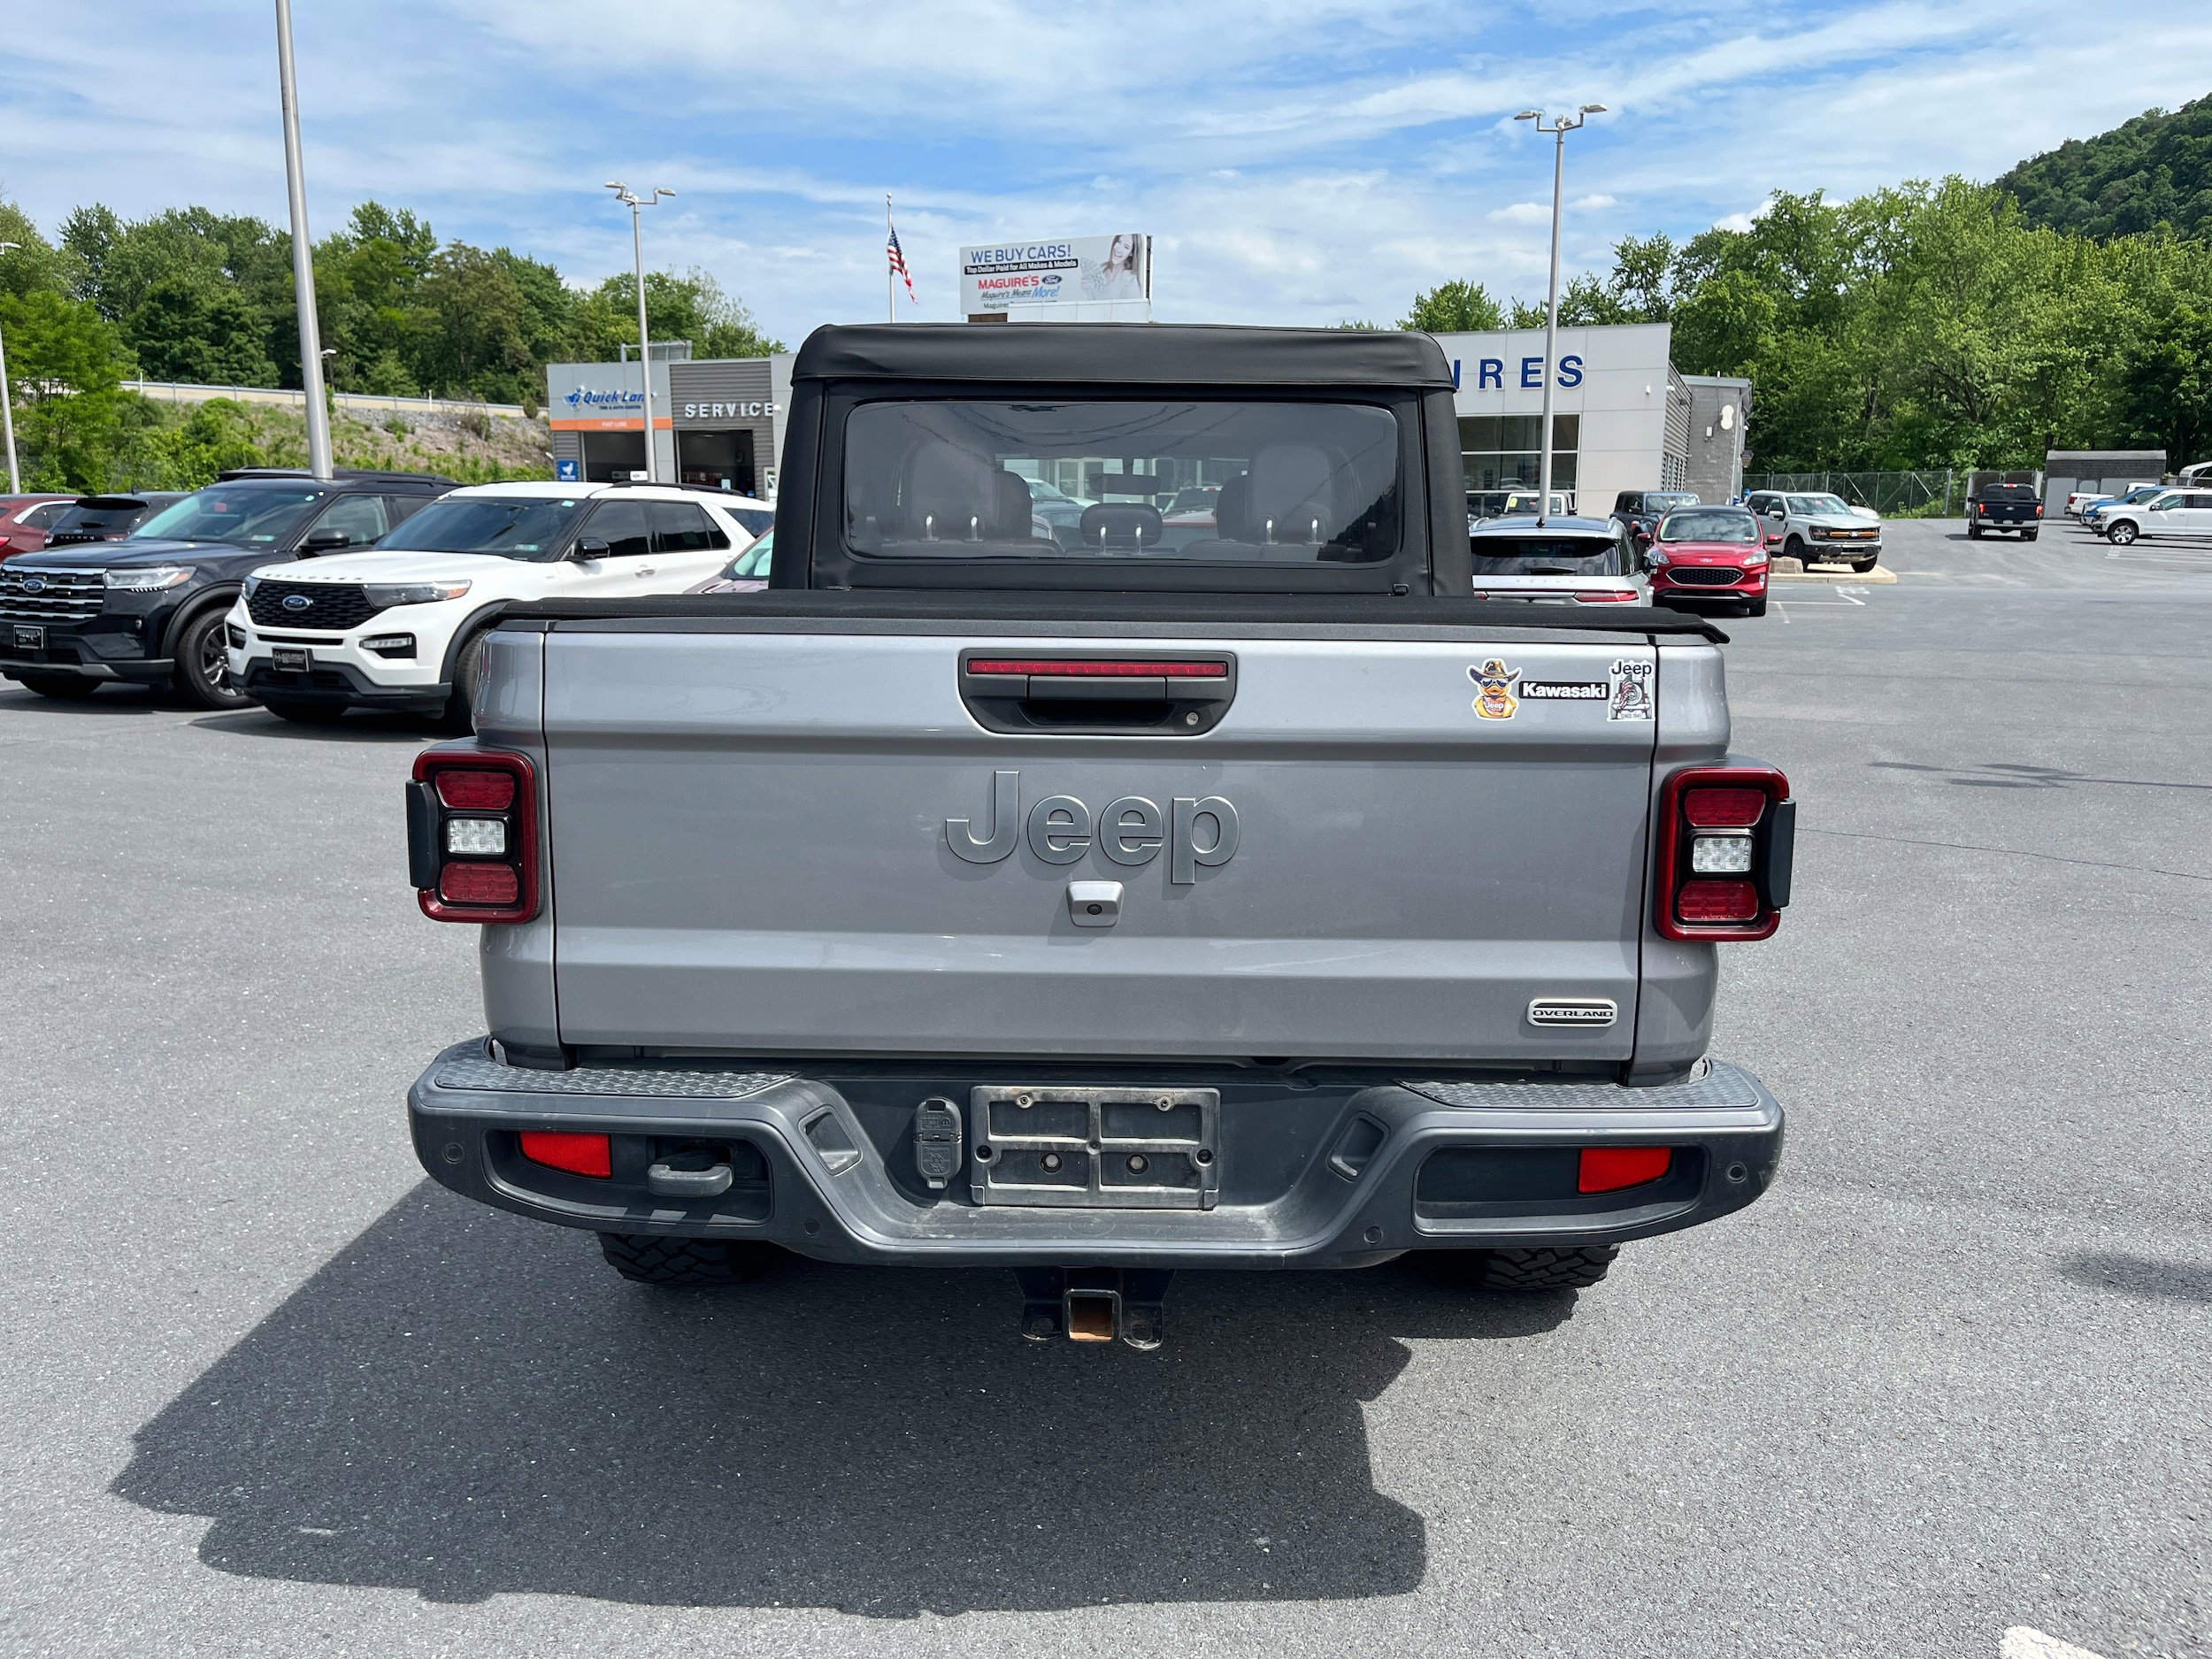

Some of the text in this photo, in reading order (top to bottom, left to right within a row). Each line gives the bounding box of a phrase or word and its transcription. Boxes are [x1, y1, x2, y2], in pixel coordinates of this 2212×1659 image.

[971, 244, 1071, 264] WE BUY CARS!
[978, 275, 1039, 289] MAGUIRE'S
[1032, 286, 1060, 298] More!
[584, 390, 654, 405] Quick Lan
[685, 402, 773, 419] SERVICE
[1611, 661, 1652, 678] Jeep
[1523, 682, 1607, 698] Kawasaki
[1485, 702, 1503, 711] Jeep
[944, 770, 1240, 885] Jeep
